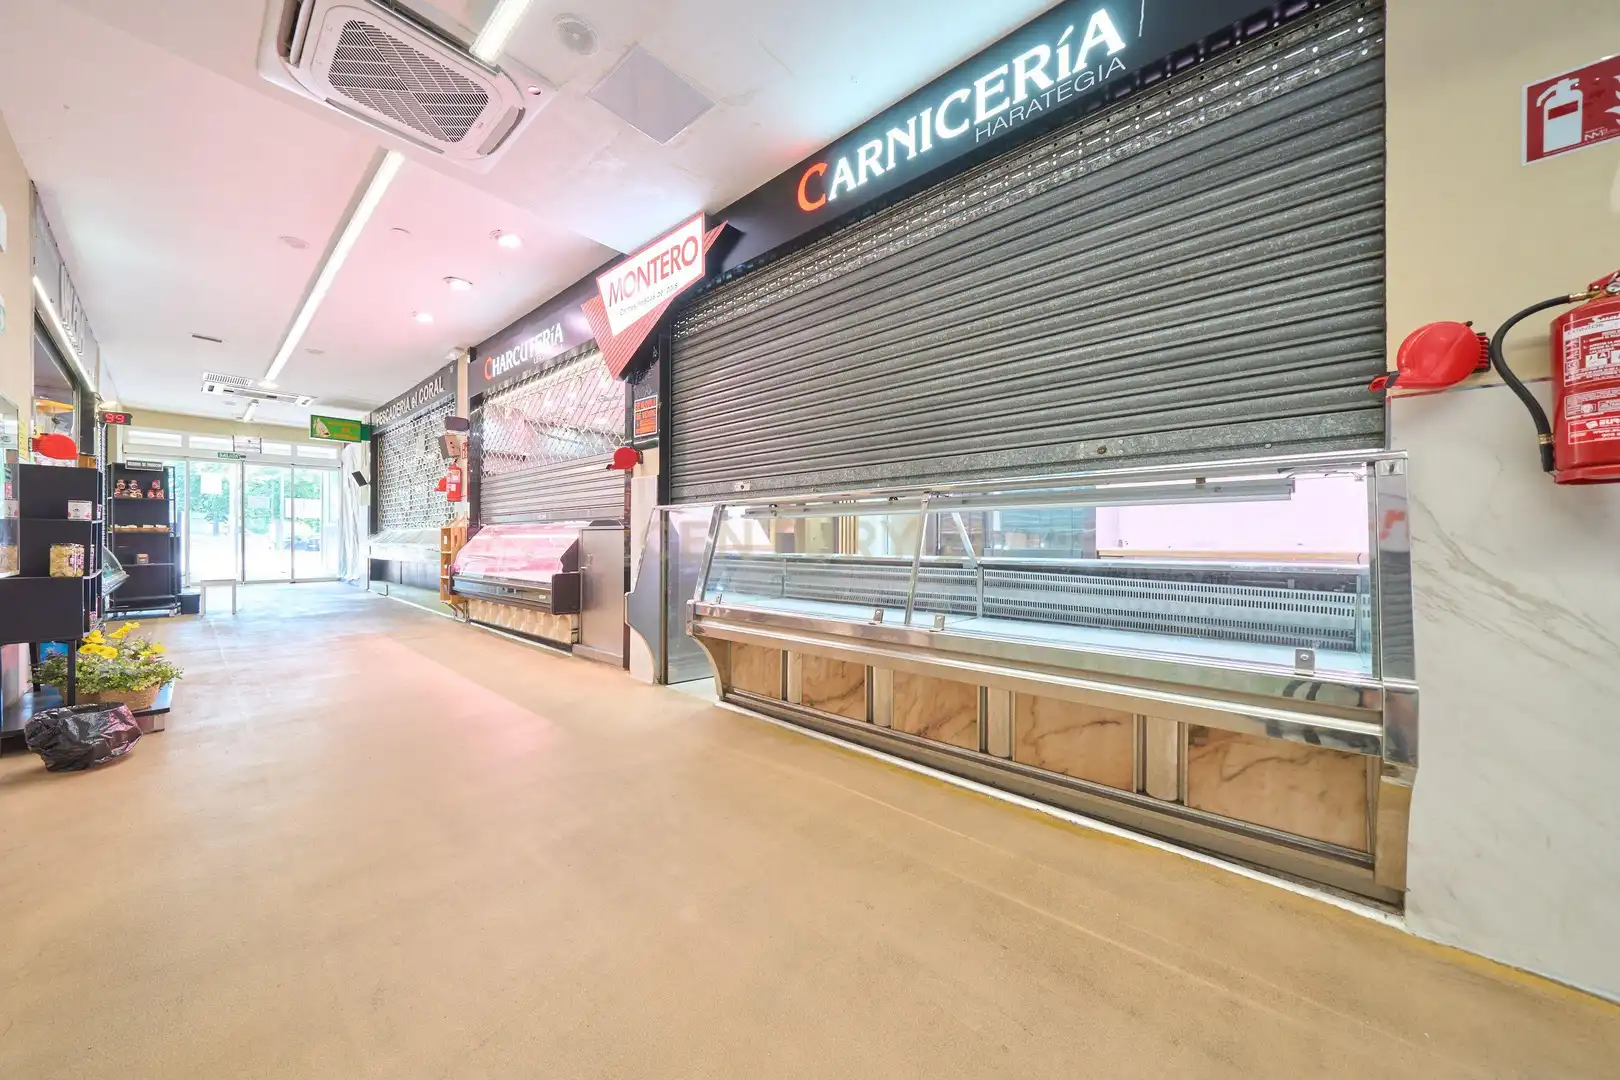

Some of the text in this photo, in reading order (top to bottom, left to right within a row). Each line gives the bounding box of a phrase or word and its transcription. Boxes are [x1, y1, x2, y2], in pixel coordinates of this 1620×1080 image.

[975, 57, 1126, 143] HARATEGIA
[609, 235, 698, 307] MONTERO
[419, 376, 446, 404] CORAL
[105, 413, 126, 423] 99
